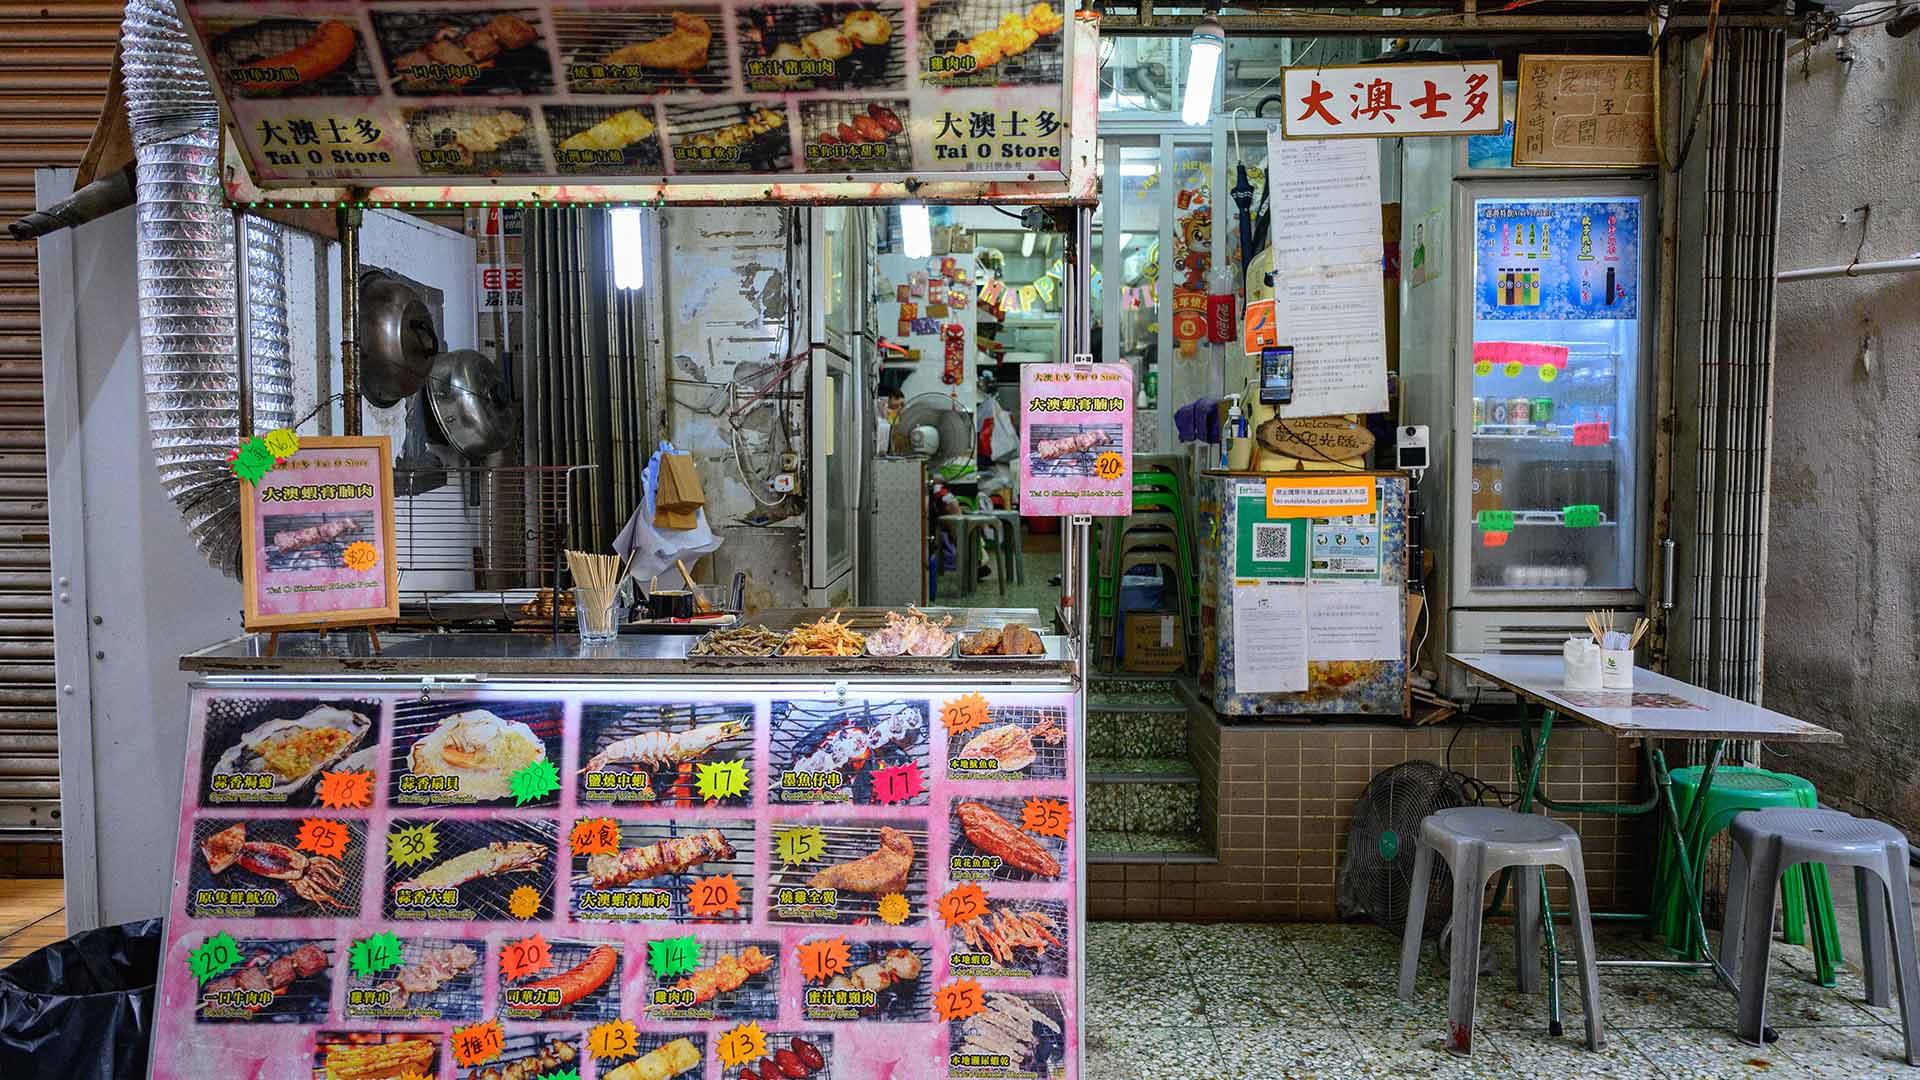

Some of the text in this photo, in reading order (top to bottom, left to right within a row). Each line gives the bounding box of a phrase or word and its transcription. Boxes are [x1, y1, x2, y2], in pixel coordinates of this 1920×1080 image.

[929, 55, 976, 72] 雞肉串
[1297, 74, 1489, 125] 大澳士多
[256, 117, 382, 145] 大澳士多
[935, 110, 1061, 138] 大澳士多
[265, 149, 391, 165] Tai O Store
[936, 144, 1059, 160] Tai O Store
[1030, 397, 1124, 412] 大澳蝦膏腩肉
[1294, 419, 1344, 428] Welcome
[1100, 458, 1119, 474] 20
[262, 484, 374, 502] 大澳蝦膏腩肉
[348, 549, 375, 565] $20
[948, 706, 972, 726] 25
[949, 758, 999, 769] 本地魷魚乾
[213, 773, 274, 790] 蒜香焗蠔
[400, 775, 460, 792] 蒜香扇貝
[586, 772, 646, 789] 鹽燒中蝦
[713, 769, 732, 792] 17
[782, 772, 842, 788] 墨魚仔串
[889, 772, 909, 794] 17
[332, 780, 356, 800] 18
[1032, 805, 1063, 829] 35
[311, 826, 337, 848] 95
[400, 832, 425, 856] 38
[576, 825, 613, 848] 必食
[790, 834, 813, 855] 15
[952, 858, 1001, 869] 黃花魚魚子
[197, 890, 278, 906] 原隻鮮魷魚
[396, 889, 457, 906] 蒜香大蝦
[581, 891, 671, 908] 大澳蝦膏腩肉
[702, 886, 728, 907] 20
[779, 889, 838, 905] 燒雞全翼
[949, 894, 977, 918] 25
[200, 946, 228, 974] 20
[367, 945, 390, 968] 14
[513, 945, 540, 969] 20
[665, 947, 687, 969] 14
[817, 947, 837, 972] 16
[951, 954, 991, 966] 本地蝦乾
[204, 990, 272, 1006] 一口牛肉串
[350, 990, 390, 1005] 雞腎串
[507, 989, 561, 1004] 司華力腸
[654, 990, 696, 1004] 雞肉串
[808, 990, 875, 1005] 蜜汁豬頸肉
[947, 989, 974, 1013] 25
[460, 1028, 499, 1058] 推介
[603, 1029, 628, 1051] 13
[730, 1034, 755, 1058] 13
[950, 1055, 1011, 1066] 本地瀨尿蝦乾
